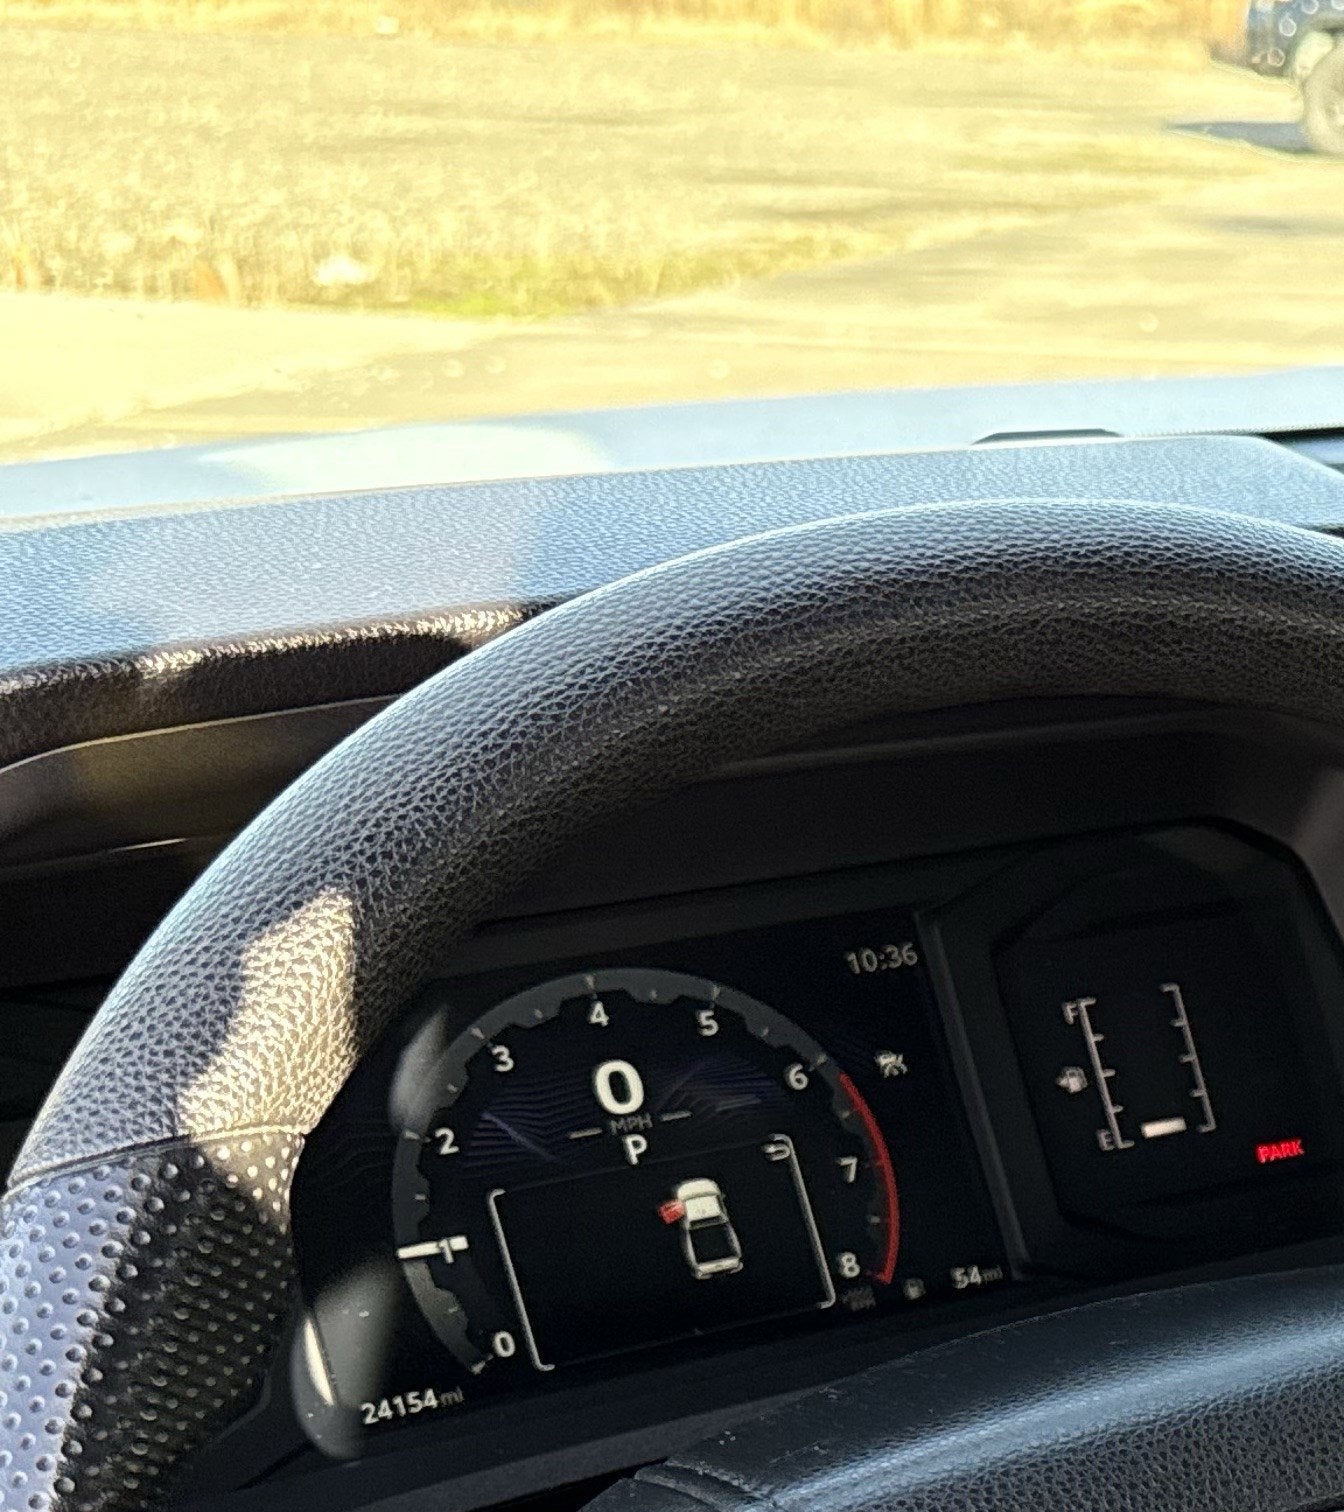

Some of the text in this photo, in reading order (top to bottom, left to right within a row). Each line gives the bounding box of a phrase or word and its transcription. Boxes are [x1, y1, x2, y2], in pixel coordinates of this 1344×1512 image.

[847, 941, 918, 974] 10:36
[588, 1002, 610, 1028] 4
[698, 1010, 719, 1036] 5
[1062, 1001, 1079, 1025] F
[491, 1044, 514, 1072] 3
[594, 1059, 645, 1115] 0
[787, 1066, 808, 1090] 6
[609, 1112, 653, 1135] MPH
[434, 1127, 460, 1155] 2
[623, 1133, 648, 1166] P
[1097, 1128, 1115, 1151] E
[1256, 1138, 1305, 1164] PARK
[838, 1157, 858, 1182] 7
[438, 1238, 455, 1264] 1
[838, 1252, 861, 1278] 8
[493, 1330, 516, 1358] 0
